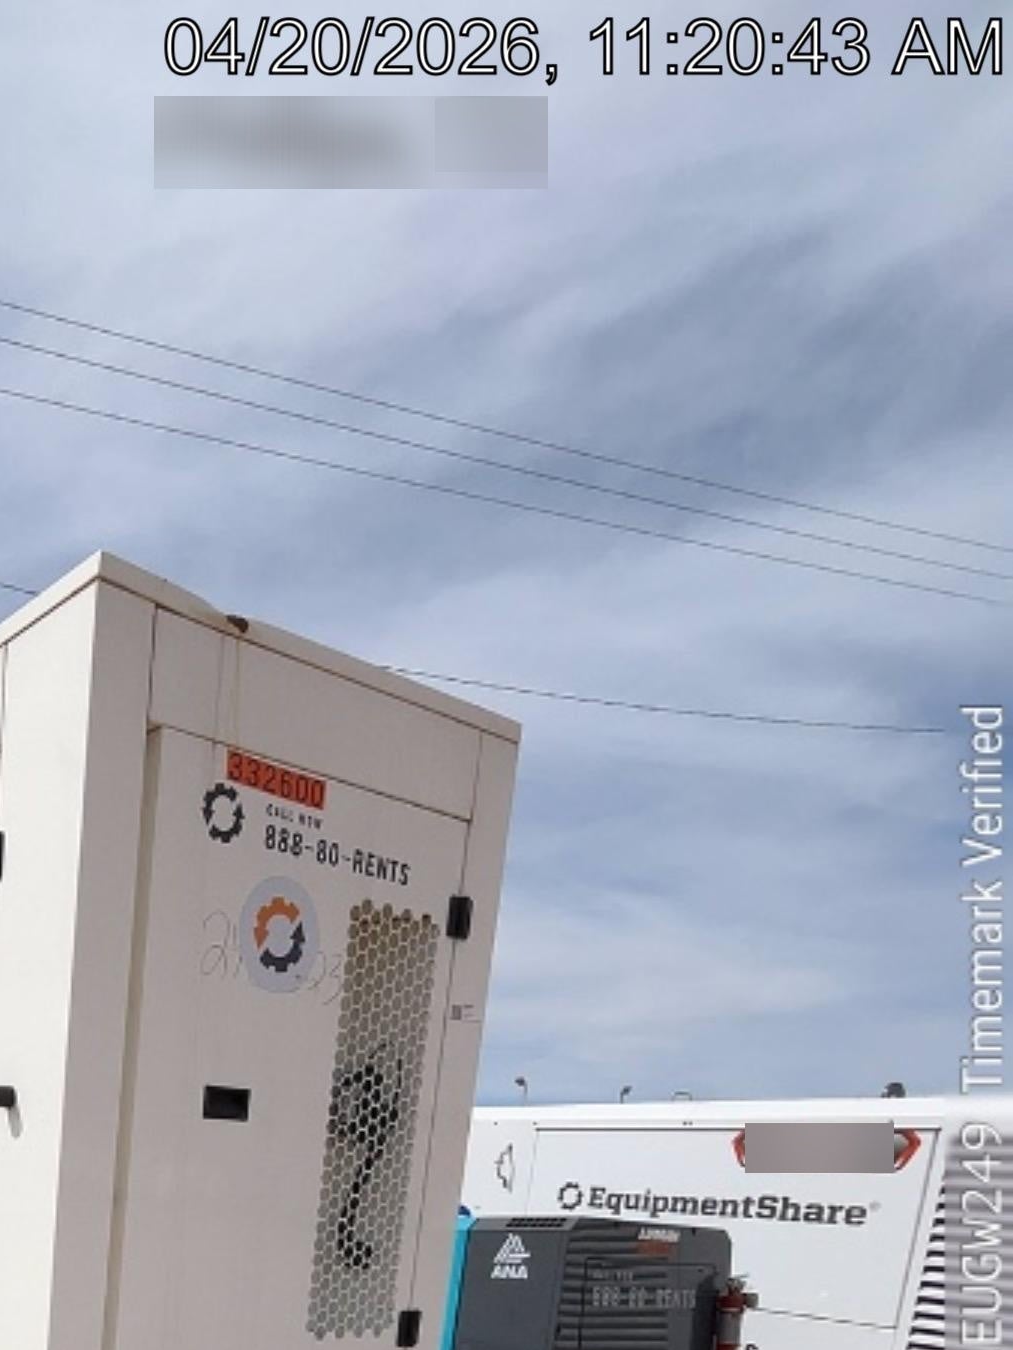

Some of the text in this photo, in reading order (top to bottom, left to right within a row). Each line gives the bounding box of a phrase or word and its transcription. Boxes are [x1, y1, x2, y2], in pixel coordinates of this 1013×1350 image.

[228, 752, 325, 808] 332600
[265, 824, 411, 886] 888-80-RENTS
[588, 1186, 868, 1226] EquipmentShare
